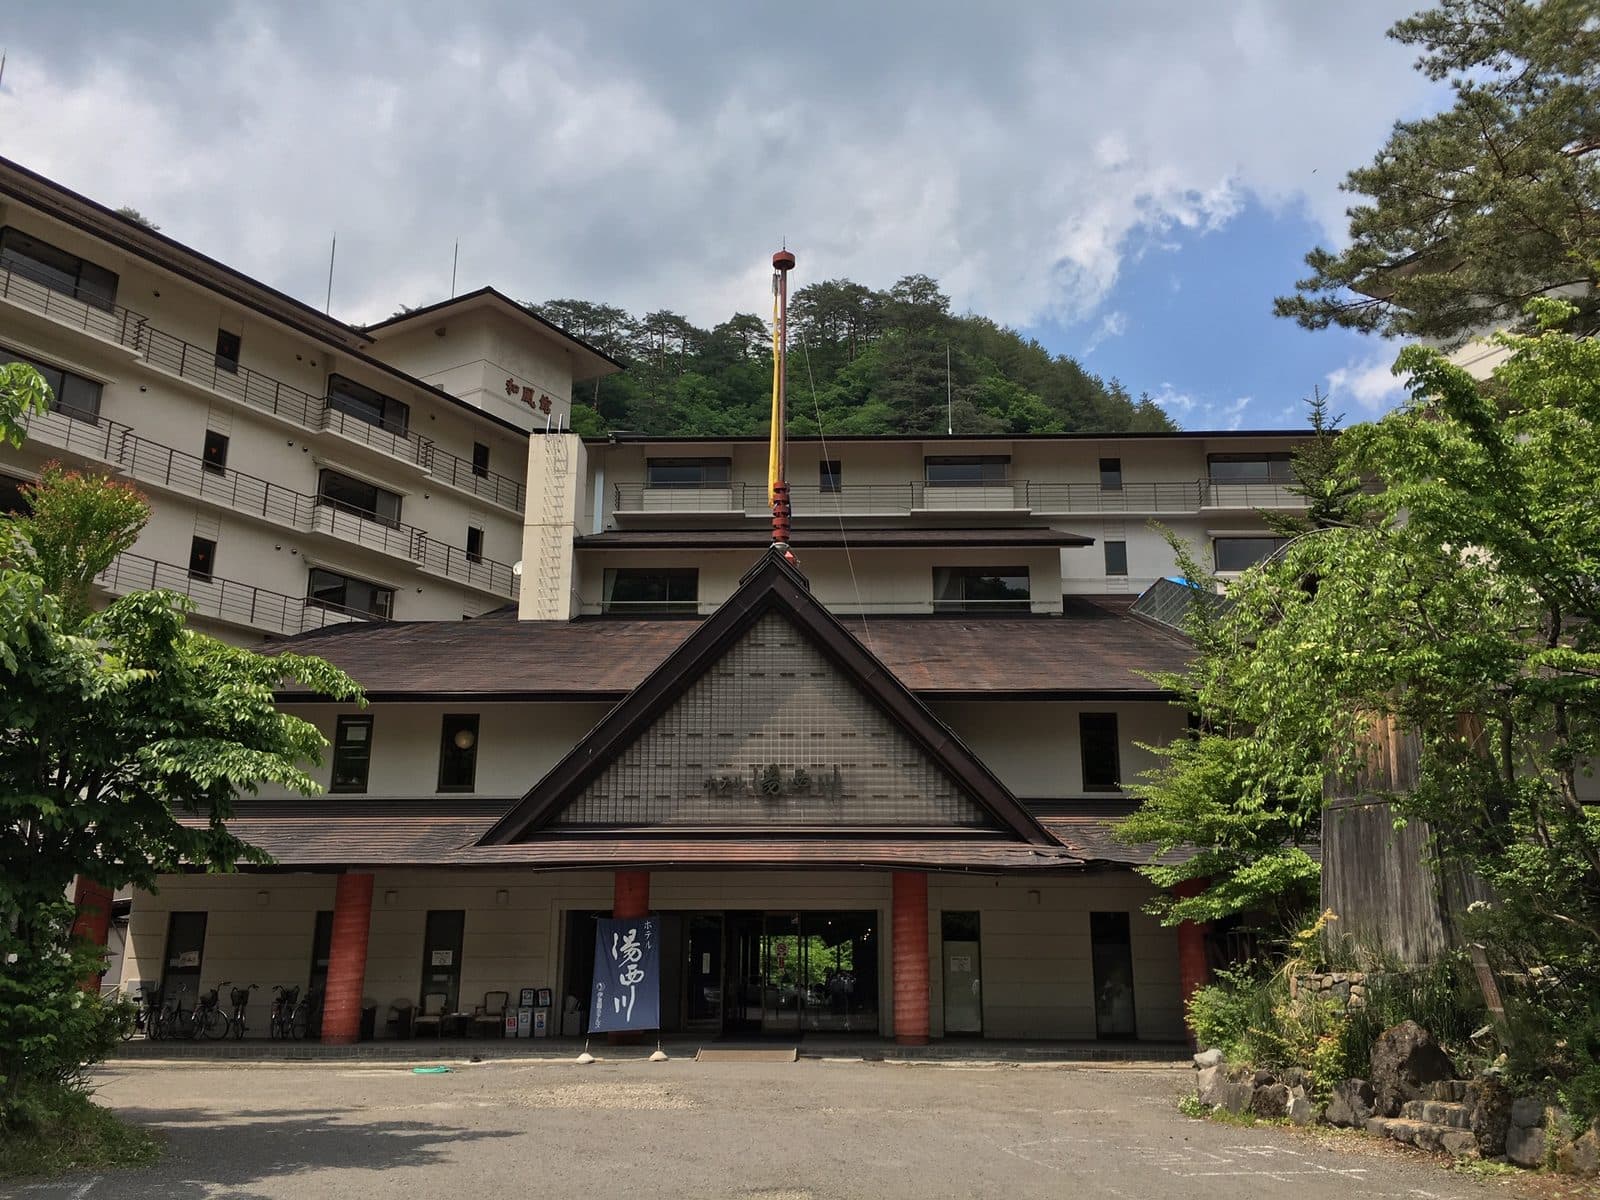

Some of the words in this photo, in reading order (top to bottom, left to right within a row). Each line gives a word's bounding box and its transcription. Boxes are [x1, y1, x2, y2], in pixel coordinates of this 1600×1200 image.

[644, 920, 653, 950] ホテル
[611, 928, 645, 1022] 湯西川
